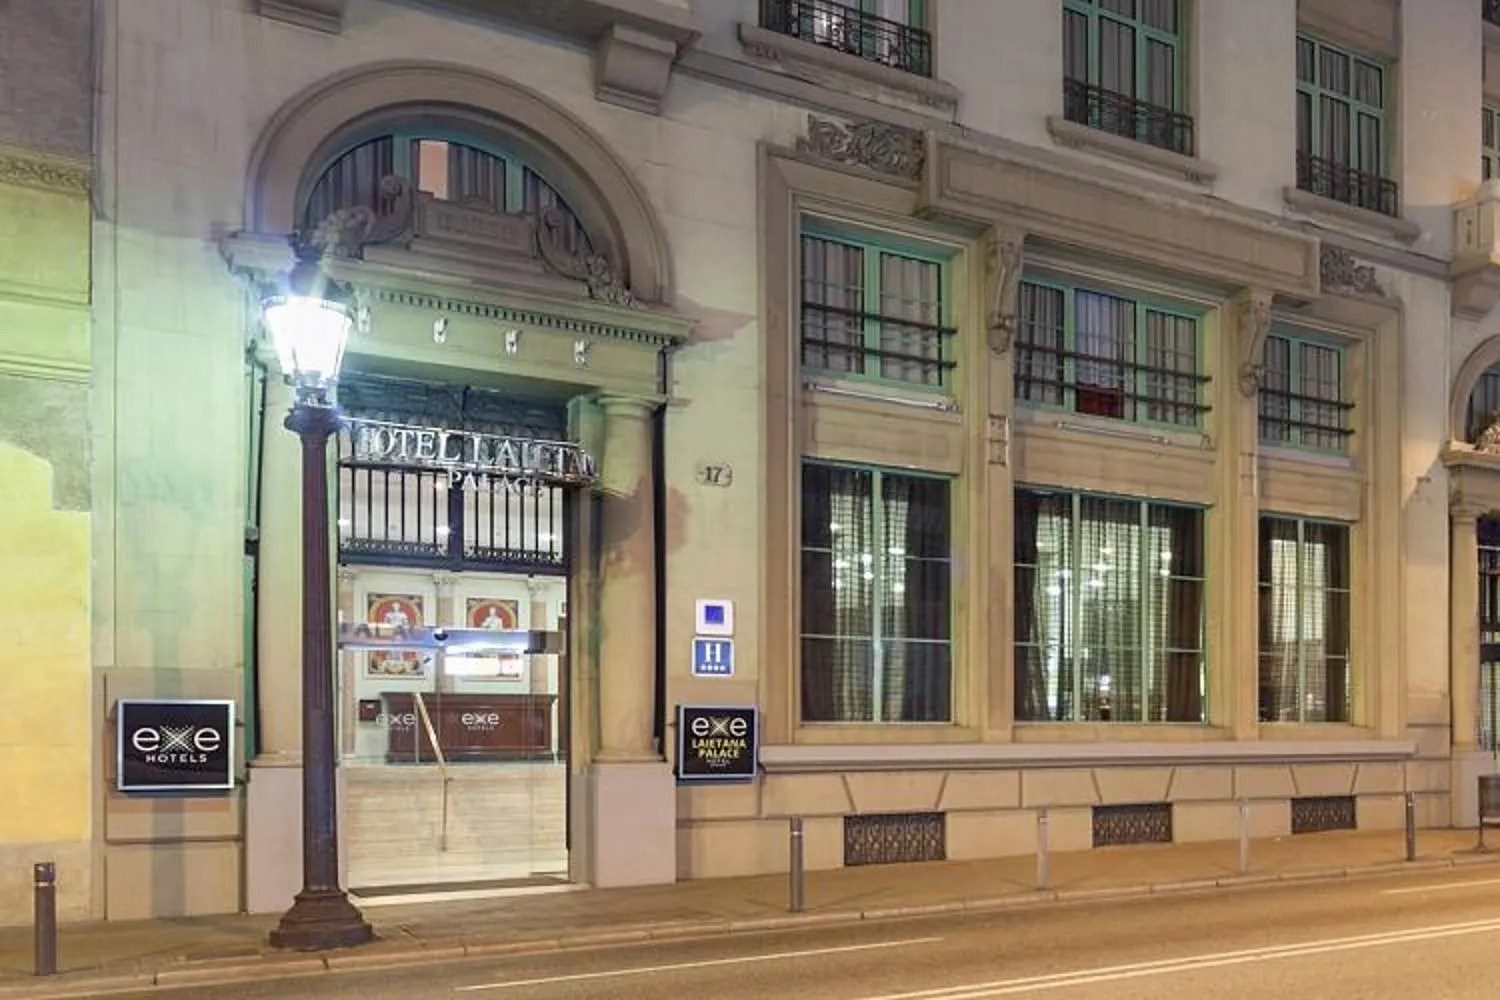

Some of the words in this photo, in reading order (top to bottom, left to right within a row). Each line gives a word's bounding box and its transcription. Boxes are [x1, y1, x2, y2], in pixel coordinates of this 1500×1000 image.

[357, 427, 460, 461] HOTEL
[705, 465, 724, 483] 17
[704, 642, 722, 663] H
[461, 712, 500, 726] exe
[692, 716, 748, 737] exe
[132, 724, 221, 753] exe
[691, 738, 748, 749] LAIETANA
[145, 753, 208, 763] HOTELS
[699, 749, 741, 759] PALACE
